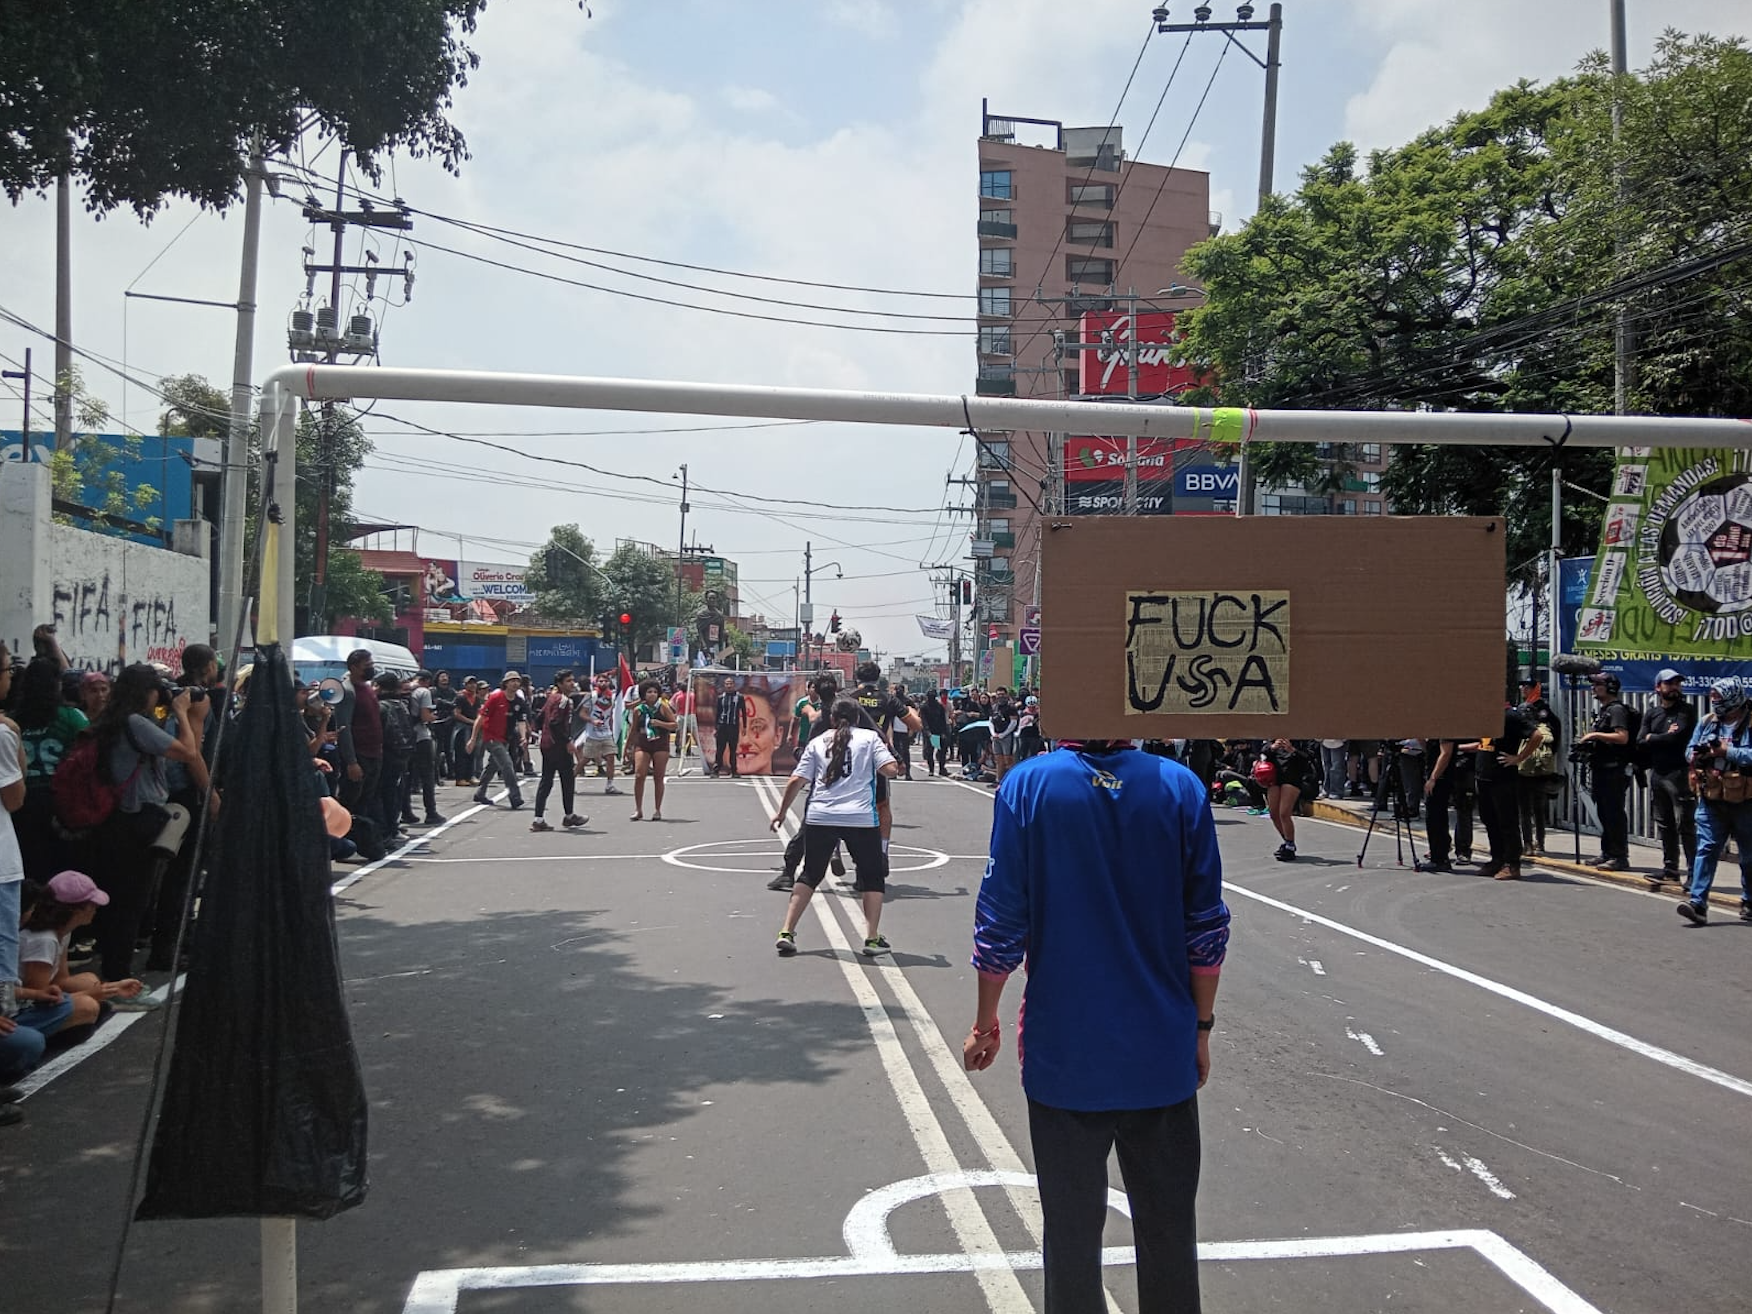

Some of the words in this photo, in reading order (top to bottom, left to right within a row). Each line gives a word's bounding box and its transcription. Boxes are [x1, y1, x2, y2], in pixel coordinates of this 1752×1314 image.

[53, 573, 110, 637] FIFA
[133, 597, 176, 649] FIFA
[1125, 592, 1287, 654] FUCK
[1126, 652, 1279, 713] USA
